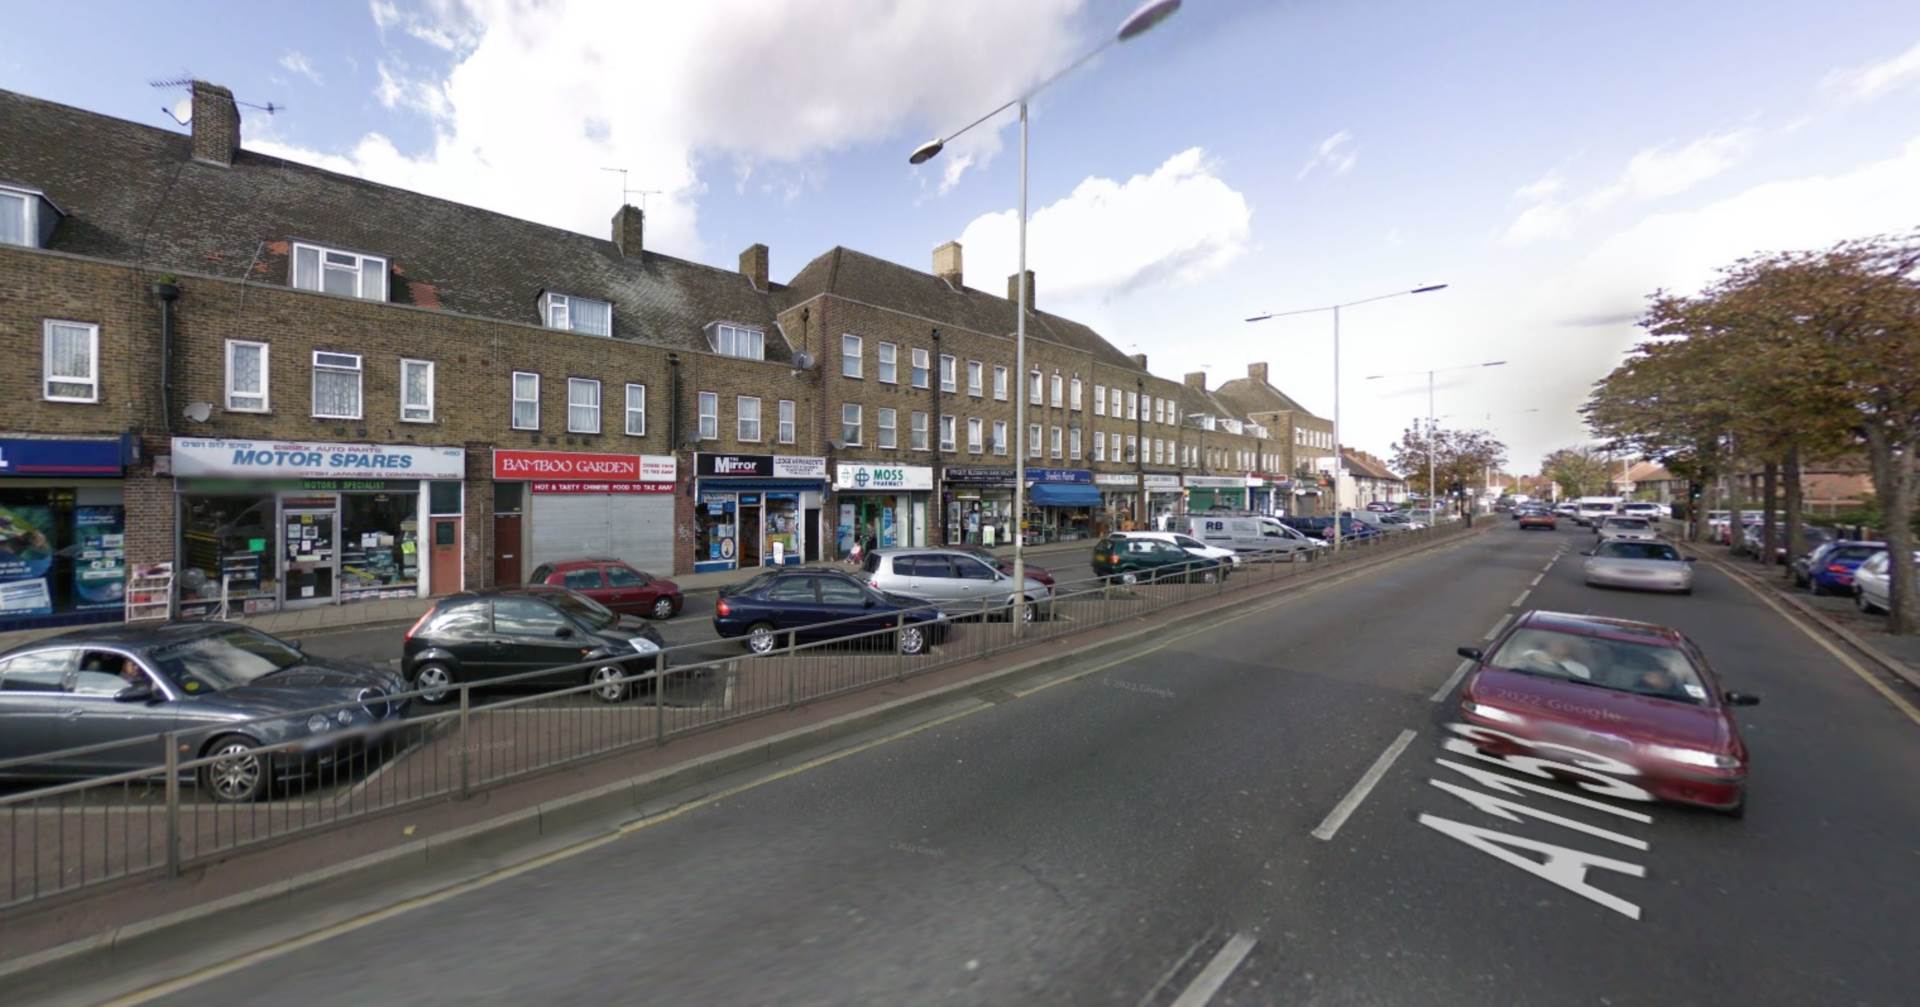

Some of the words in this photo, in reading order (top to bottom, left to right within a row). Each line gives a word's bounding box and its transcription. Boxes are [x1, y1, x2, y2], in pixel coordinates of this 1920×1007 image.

[232, 450, 323, 466] MOTOR
[329, 453, 413, 468] SPARES
[503, 458, 573, 472] BAMBOO
[576, 460, 634, 473] GARDEN
[714, 456, 757, 473] Mirror
[874, 468, 904, 480] MOSS
[343, 481, 385, 489] SPECIALIST
[1205, 521, 1223, 530] RB
